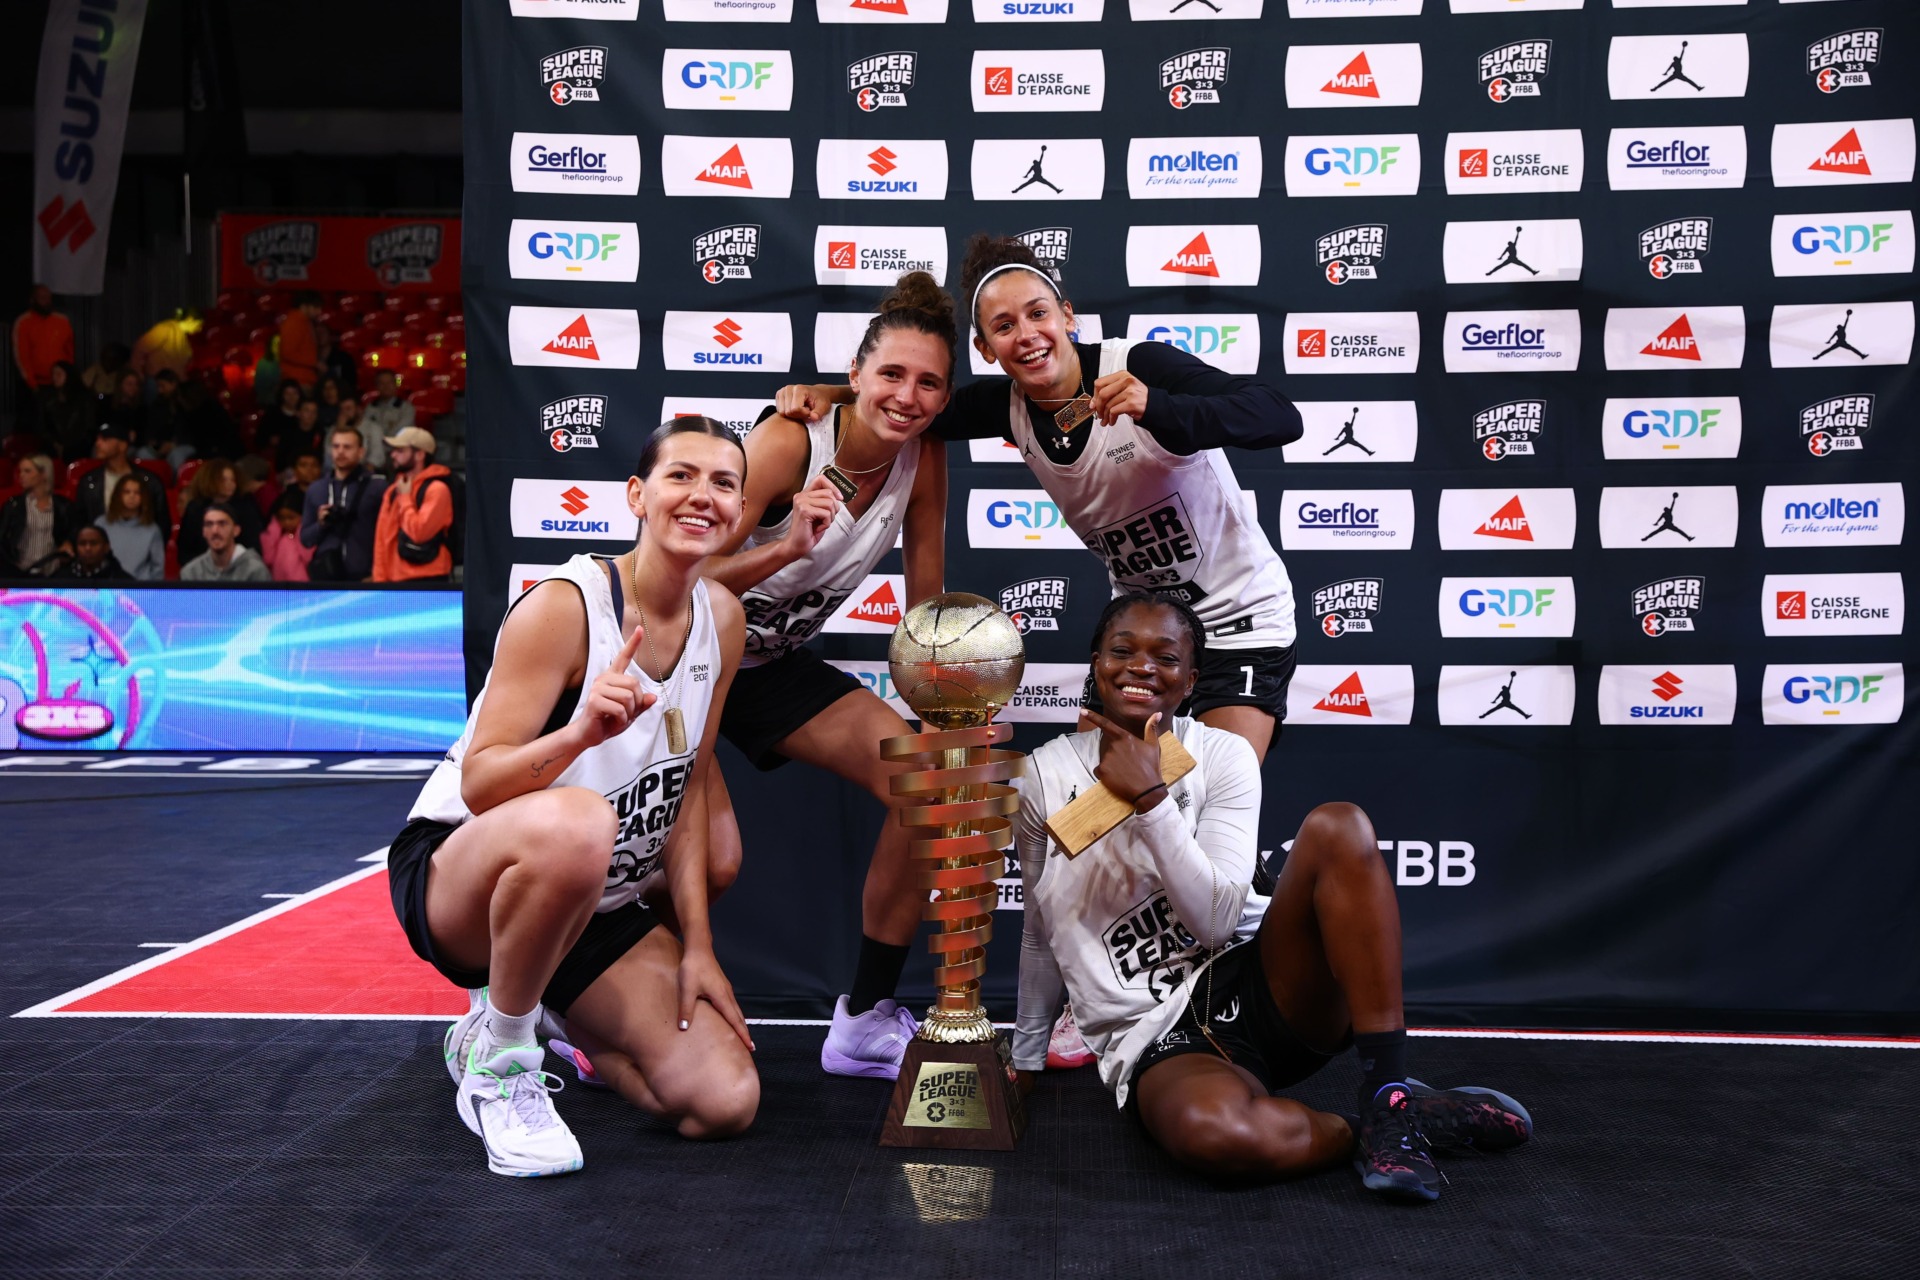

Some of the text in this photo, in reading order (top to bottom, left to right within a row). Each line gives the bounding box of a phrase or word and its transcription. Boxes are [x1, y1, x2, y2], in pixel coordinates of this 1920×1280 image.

[1004, 3, 1073, 14] SUZUKI
[1809, 31, 1879, 60] SUPER
[543, 49, 604, 73] SUPER
[850, 54, 913, 79] SUPER
[1162, 50, 1226, 76] SUPER
[1481, 43, 1548, 70] SUPER
[1810, 48, 1877, 71] LEAGUE
[544, 64, 603, 84] LEAGUE
[682, 61, 773, 89] GRDF
[851, 70, 912, 90] LEAGUE
[1018, 74, 1063, 83] CAISSE
[1163, 67, 1225, 87] LEAGUE
[1482, 59, 1546, 81] LEAGUE
[1844, 75, 1863, 83] FFBB
[1331, 74, 1373, 88] MAIF
[1515, 85, 1533, 93] FFBB
[575, 90, 592, 98] FFBB
[529, 145, 605, 168] Gerflor
[1149, 151, 1237, 172] molten
[1305, 147, 1399, 176] GRDF
[1493, 154, 1540, 165] CAISSE
[1627, 140, 1708, 163] Gerflor
[1820, 151, 1864, 166] MAIF
[705, 165, 746, 178] MAIF
[1145, 175, 1238, 188] For the real game
[848, 181, 917, 192] SUZUKI
[696, 227, 757, 251] SUPER
[1318, 227, 1384, 252] SUPER
[1641, 220, 1708, 246] SUPER
[1792, 224, 1892, 255] GRDF
[528, 232, 620, 259] GRDF
[696, 243, 756, 262] LEAGUE
[861, 249, 906, 259] CAISSE
[1319, 243, 1382, 263] LEAGUE
[1642, 236, 1707, 257] LEAGUE
[1172, 253, 1213, 267] MAIF
[1676, 262, 1695, 270] FFBB
[727, 268, 745, 276] FFBB
[552, 335, 593, 349] MAIF
[1331, 336, 1377, 345] CAISSE
[1463, 323, 1544, 345] Gerflor
[1651, 336, 1694, 350] MAIF
[694, 353, 762, 364] SUZUKI
[543, 397, 603, 420] SUPER
[1476, 403, 1542, 428] SUPER
[1802, 397, 1870, 424] SUPER
[544, 412, 602, 431] LEAGUE
[1477, 418, 1540, 439] LEAGUE
[1623, 410, 1719, 438] GRDF
[1803, 413, 1869, 435] LEAGUE
[575, 437, 592, 445] FFBB
[1106, 442, 1135, 458] RENNES
[1509, 444, 1527, 452] FFBB
[1835, 439, 1854, 447] FFBB
[1114, 451, 1135, 464] 2023
[986, 501, 1065, 528] GRD
[1299, 502, 1377, 524] Gerflor
[1785, 498, 1879, 519] molten
[541, 520, 608, 532] SUZUKI
[1485, 517, 1527, 531] MAIF
[1781, 522, 1878, 535] For the real game
[1002, 580, 1065, 603] SUPER
[1315, 581, 1379, 605] SUPER
[1634, 579, 1701, 604] SUPER
[857, 602, 898, 616] MAIF
[1003, 595, 1064, 614] LEAGUE
[1315, 596, 1378, 616] LEAGUE
[1459, 589, 1554, 617] GRDF
[1635, 595, 1700, 615] LEAGUE
[1812, 597, 1860, 607] CAISSE
[693, 673, 708, 682] 202
[1238, 665, 1257, 697] 1
[1014, 686, 1059, 696] CAISSE
[1324, 693, 1365, 706] MAIF
[1783, 676, 1881, 704] GRDF
[1630, 706, 1703, 717] SUZUKI
[919, 1071, 977, 1092] SUPER
[919, 1086, 976, 1102] LEAGUE
[948, 1109, 965, 1117] FFBB
